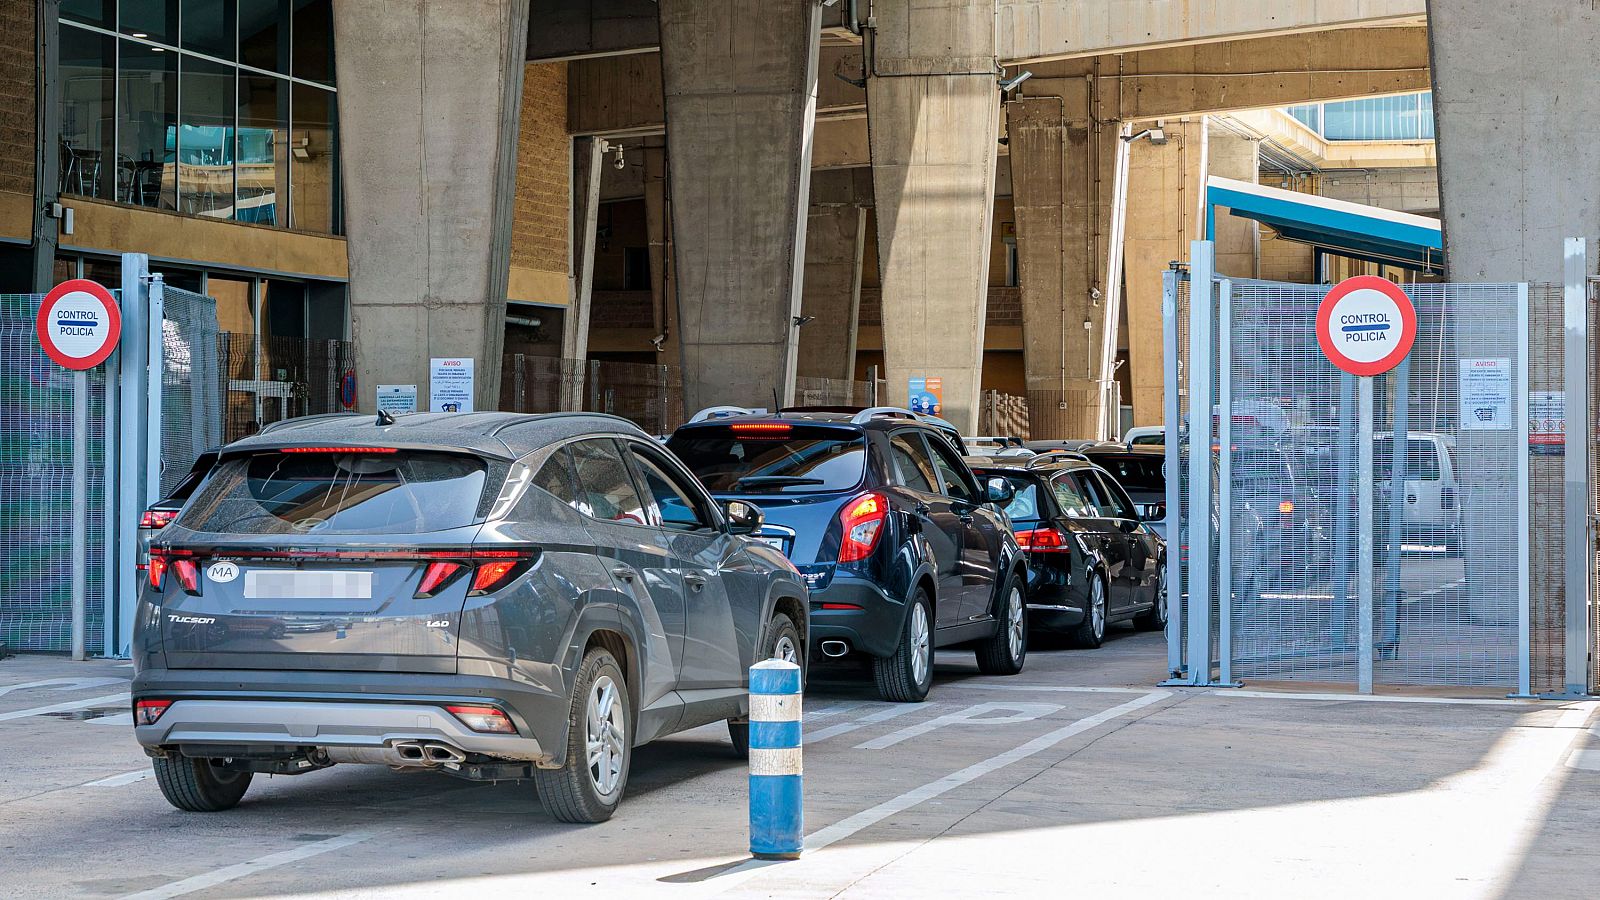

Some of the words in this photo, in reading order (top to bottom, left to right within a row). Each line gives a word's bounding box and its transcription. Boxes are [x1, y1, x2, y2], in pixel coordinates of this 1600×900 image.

[57, 310, 98, 320] CONTROL
[1340, 313, 1390, 324] CONTROL
[60, 326, 94, 336] POLICIA
[1345, 331, 1386, 342] POLICIA
[211, 567, 233, 577] MA
